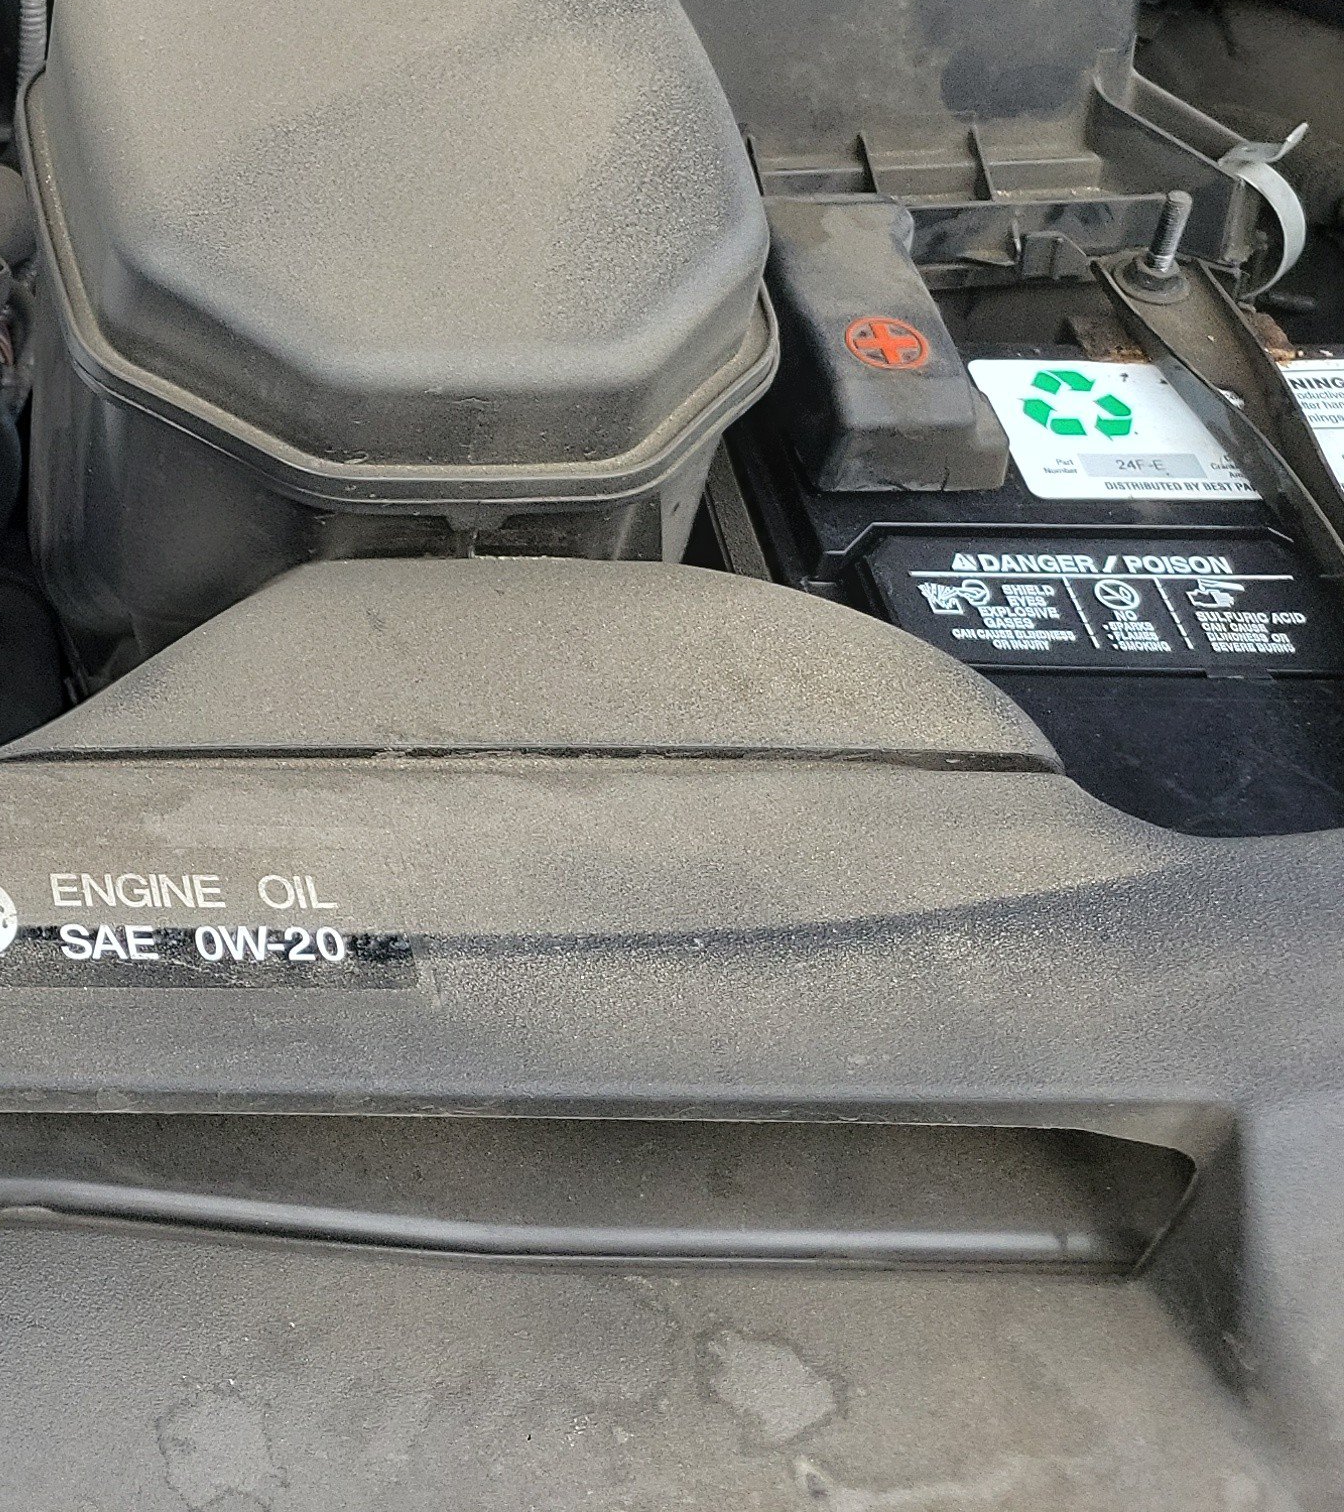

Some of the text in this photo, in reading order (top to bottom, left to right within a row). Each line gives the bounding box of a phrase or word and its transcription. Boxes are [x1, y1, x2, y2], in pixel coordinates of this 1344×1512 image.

[1289, 377, 1344, 389] NING
[1297, 391, 1344, 399] oductive
[1116, 459, 1165, 470] 24F-E
[1104, 481, 1182, 491] DISTRIBUTED
[1183, 482, 1201, 491] BY
[1234, 482, 1252, 491] PA
[977, 554, 1099, 572] DANGER
[1122, 556, 1233, 574] POISON
[1001, 584, 1055, 597] SHIELD
[1006, 596, 1048, 607] EYES
[977, 606, 1060, 619] EXPLOSIVE
[1113, 611, 1138, 622] NO
[1195, 611, 1307, 625] SULFURIC ACID
[983, 617, 1035, 629] GASES
[1201, 622, 1269, 633] CAN CAUSE
[952, 628, 1076, 641] CAN CAUSE BLINDNESS
[1204, 632, 1290, 643] BLINDNESS OR
[50, 873, 339, 910] ENGINE OIL
[58, 925, 346, 962] SAE 0W-20
